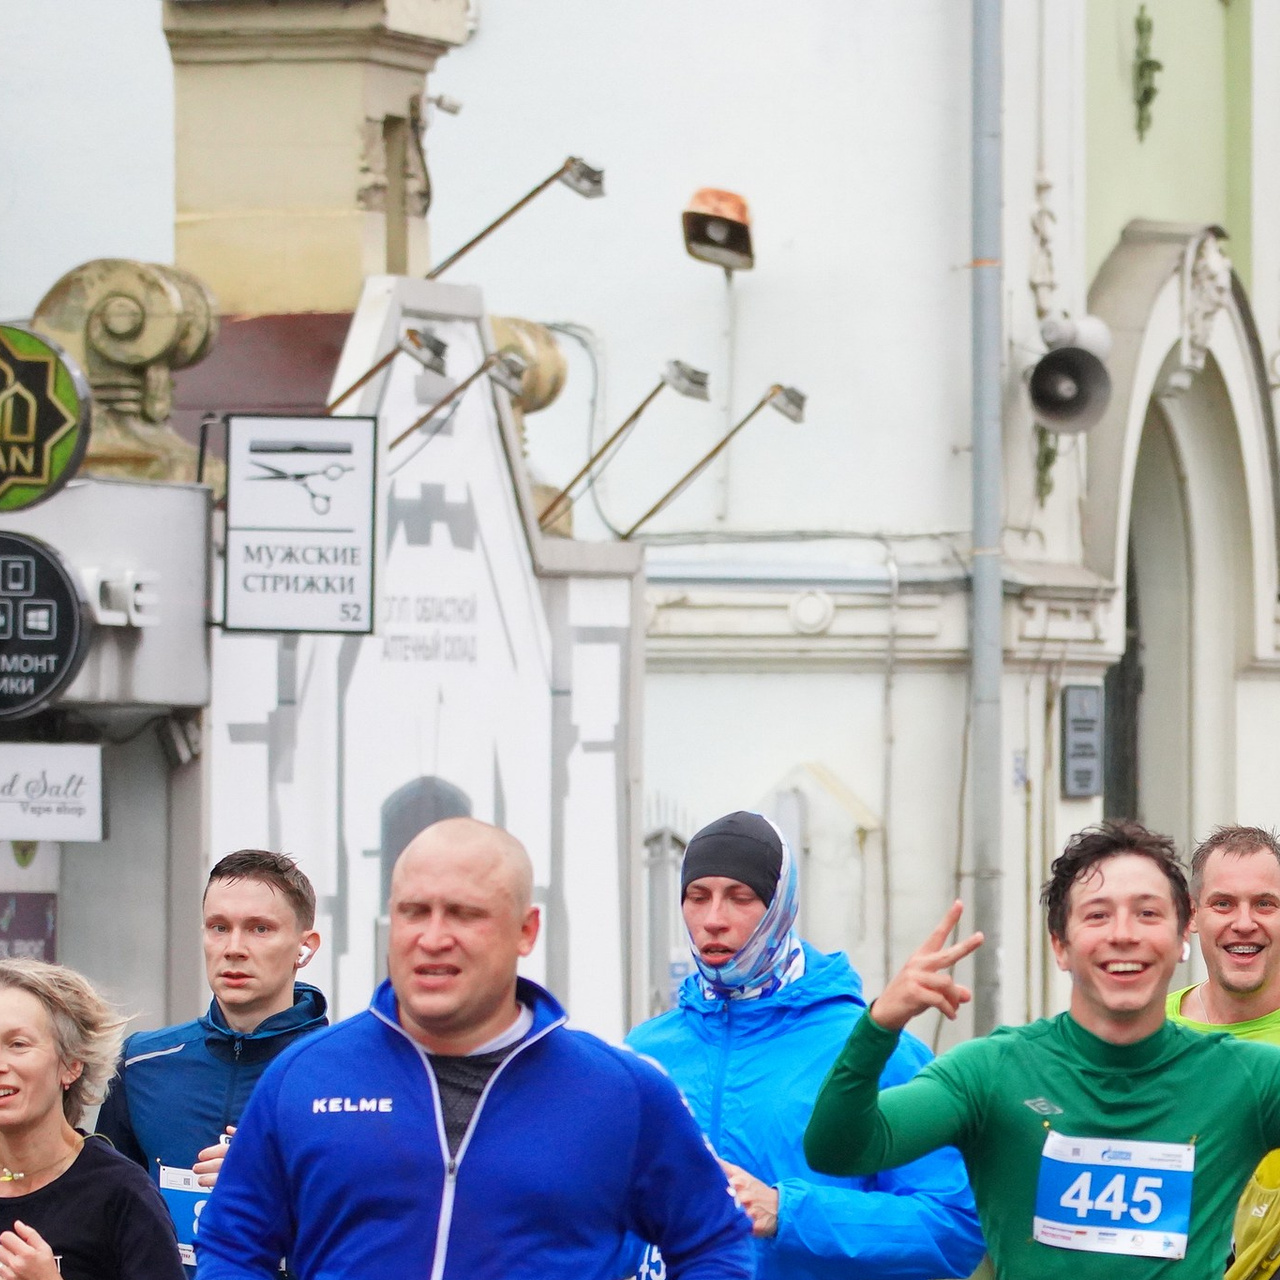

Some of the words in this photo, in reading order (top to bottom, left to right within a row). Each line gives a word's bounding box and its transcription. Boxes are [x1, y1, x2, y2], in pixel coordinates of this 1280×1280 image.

[243, 545, 362, 569] МУЖСКИЕ
[242, 573, 355, 595] СТРИЖКИ
[340, 602, 363, 622] 52
[24, 769, 87, 800] Salt
[312, 1097, 393, 1114] KELME
[1059, 1171, 1163, 1224] 445
